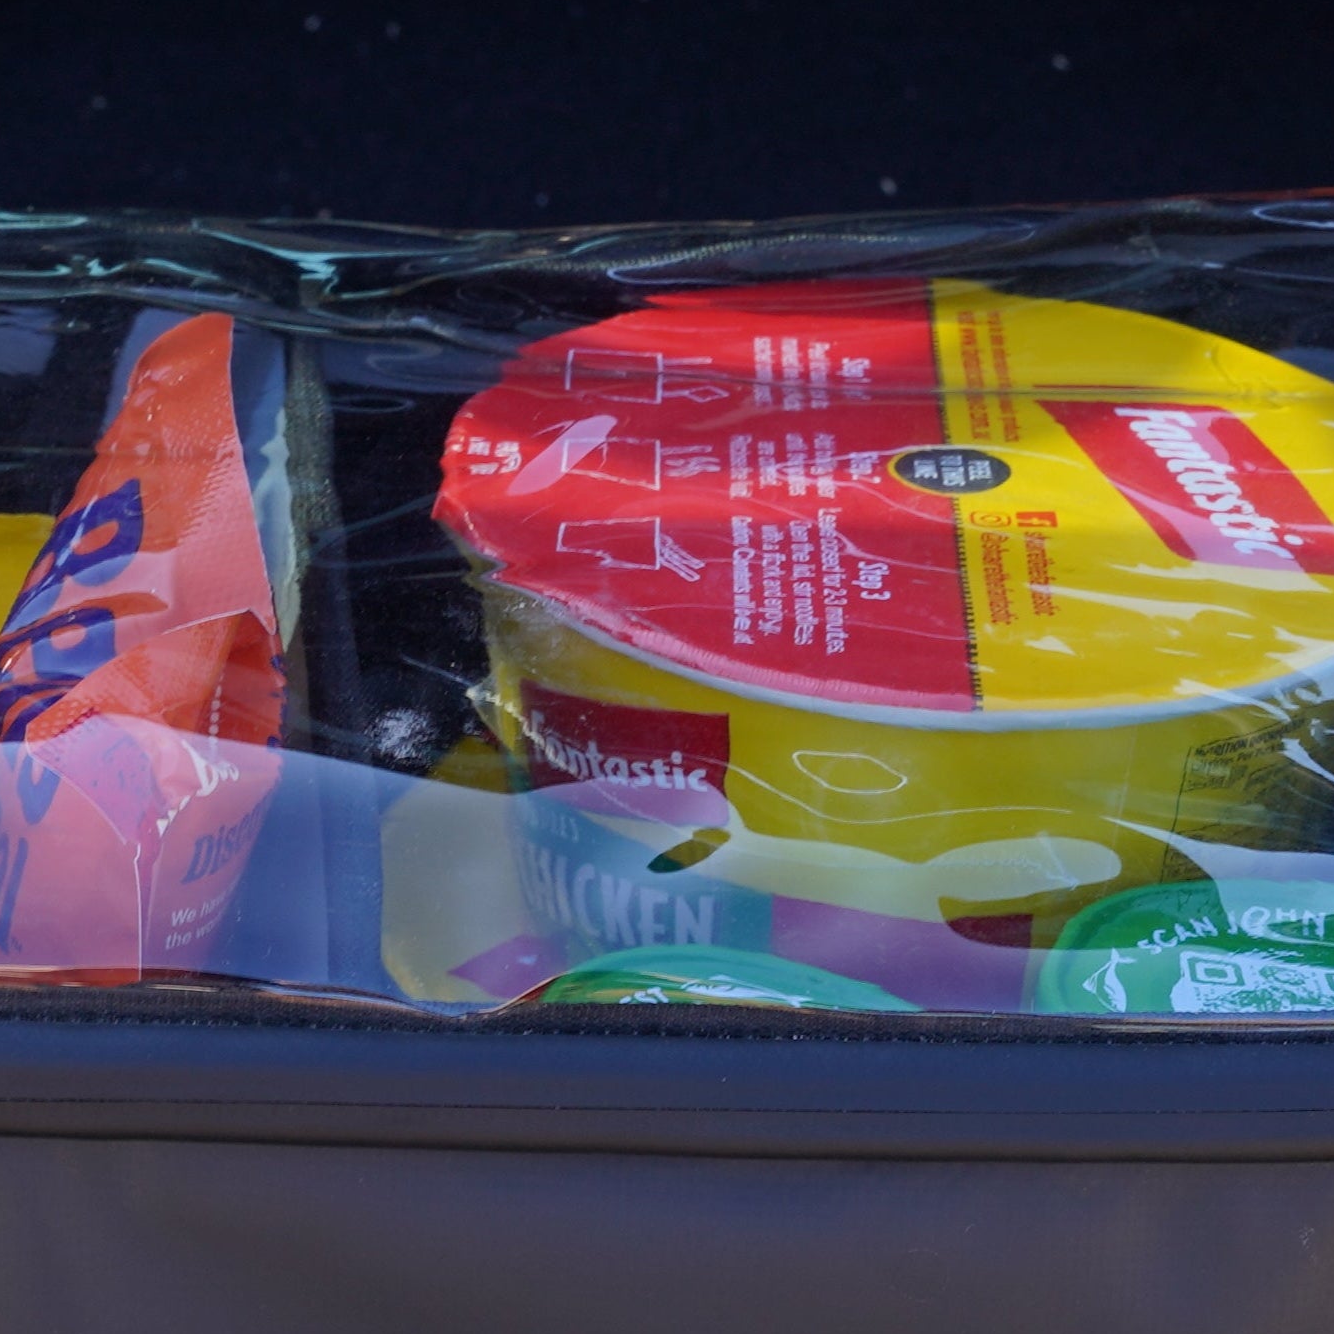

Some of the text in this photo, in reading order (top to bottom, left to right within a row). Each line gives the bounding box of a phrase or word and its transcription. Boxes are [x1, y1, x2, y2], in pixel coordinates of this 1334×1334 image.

[913, 459, 938, 479] LINE
[940, 454, 966, 487] TO THIS
[968, 459, 992, 481] PEEL
[1114, 407, 1304, 560] Fantastic
[818, 507, 843, 537] Leave
[791, 543, 815, 562] the
[820, 538, 845, 572] closed
[763, 579, 787, 597] and
[792, 582, 816, 597] stir
[822, 574, 846, 588] for
[851, 561, 891, 600] Step 3
[823, 588, 848, 605] 2-3
[793, 598, 819, 646] noodles
[530, 710, 708, 792] Fantastic
[171, 907, 198, 928] We
[1137, 916, 1219, 955] SCAN
[1226, 905, 1326, 939] JOHN
